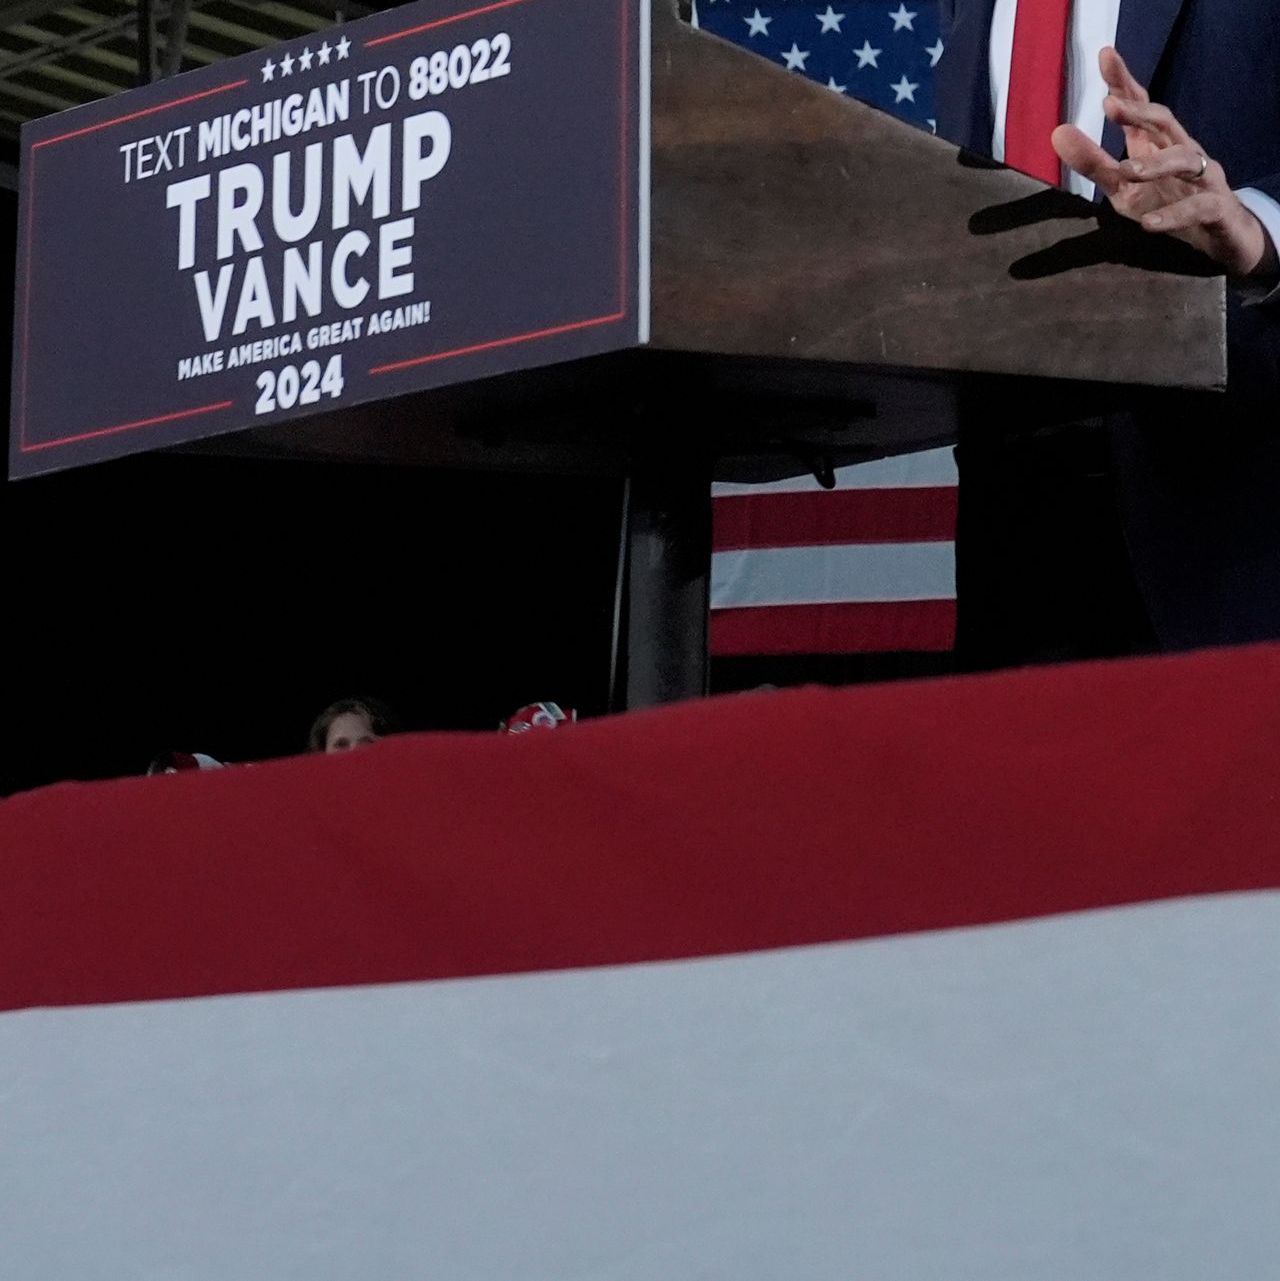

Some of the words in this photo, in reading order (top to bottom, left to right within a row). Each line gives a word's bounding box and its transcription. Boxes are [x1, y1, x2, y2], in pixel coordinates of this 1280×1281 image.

[119, 126, 192, 184] TEXT
[198, 79, 350, 161] MICHIGAN
[357, 65, 401, 115] TO
[408, 33, 511, 101] 88022
[166, 111, 452, 271] TRUMP
[177, 351, 224, 381] MAKE
[227, 332, 303, 368] AMERICA
[307, 317, 363, 349] GREAT
[367, 301, 431, 336] AGAIN!
[194, 217, 415, 343] VANCE
[255, 355, 344, 415] 2024
